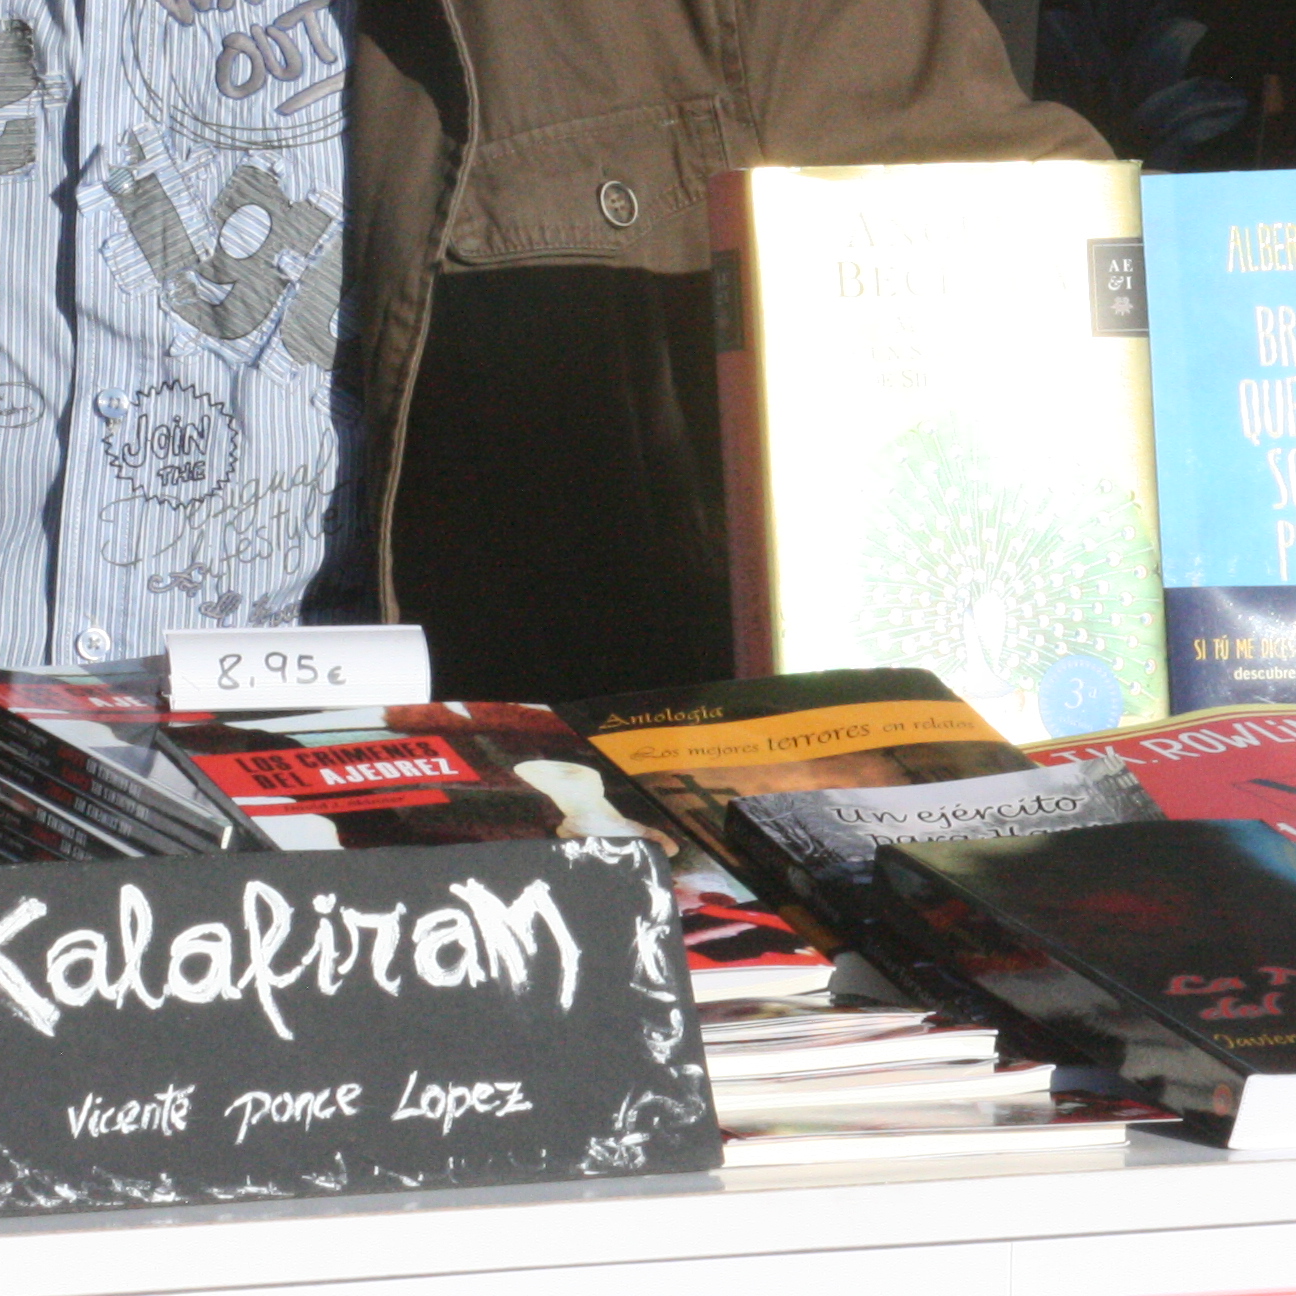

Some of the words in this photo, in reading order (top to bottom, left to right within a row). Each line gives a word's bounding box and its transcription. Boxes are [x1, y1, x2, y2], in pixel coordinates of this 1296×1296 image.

[156, 460, 207, 487] THE
[1193, 638, 1206, 662] SI
[1213, 634, 1229, 661] TÚ
[1236, 637, 1254, 660] ME
[1260, 637, 1296, 659] DICES
[1233, 664, 1296, 681] descubre
[599, 705, 724, 730] Antología
[629, 743, 680, 762] Los
[687, 740, 760, 761] mejores
[767, 721, 872, 754] terrores
[882, 720, 906, 733] en
[913, 716, 974, 731] relatos
[234, 754, 292, 774] LOS
[295, 740, 441, 770] CRÍMENES
[250, 771, 314, 790] DEL
[318, 757, 460, 787] AJEDREZ
[917, 793, 1086, 835] ejército
[1201, 991, 1283, 1021] del
[389, 1068, 536, 1137] Lopez
